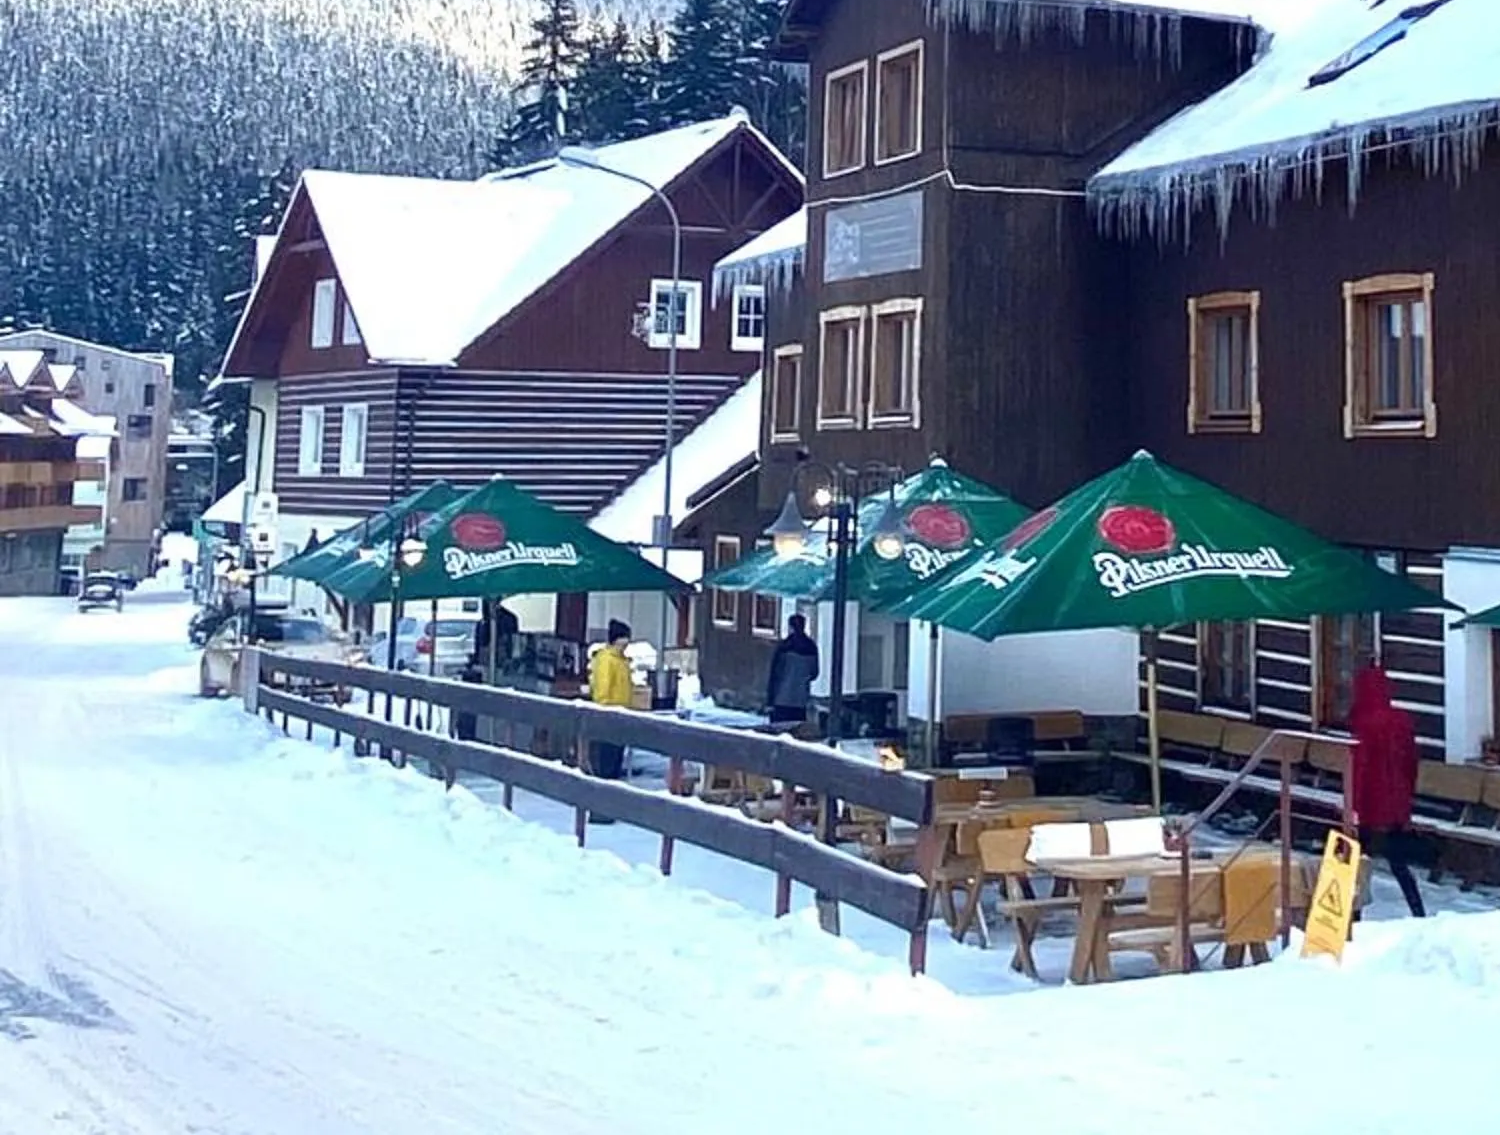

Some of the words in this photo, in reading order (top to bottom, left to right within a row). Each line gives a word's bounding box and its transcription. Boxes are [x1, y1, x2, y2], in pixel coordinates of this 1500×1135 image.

[444, 547, 511, 580] Pilsner
[505, 541, 577, 566] Urquell
[1092, 552, 1193, 597] Pilsner
[1182, 543, 1290, 579] Urquell
